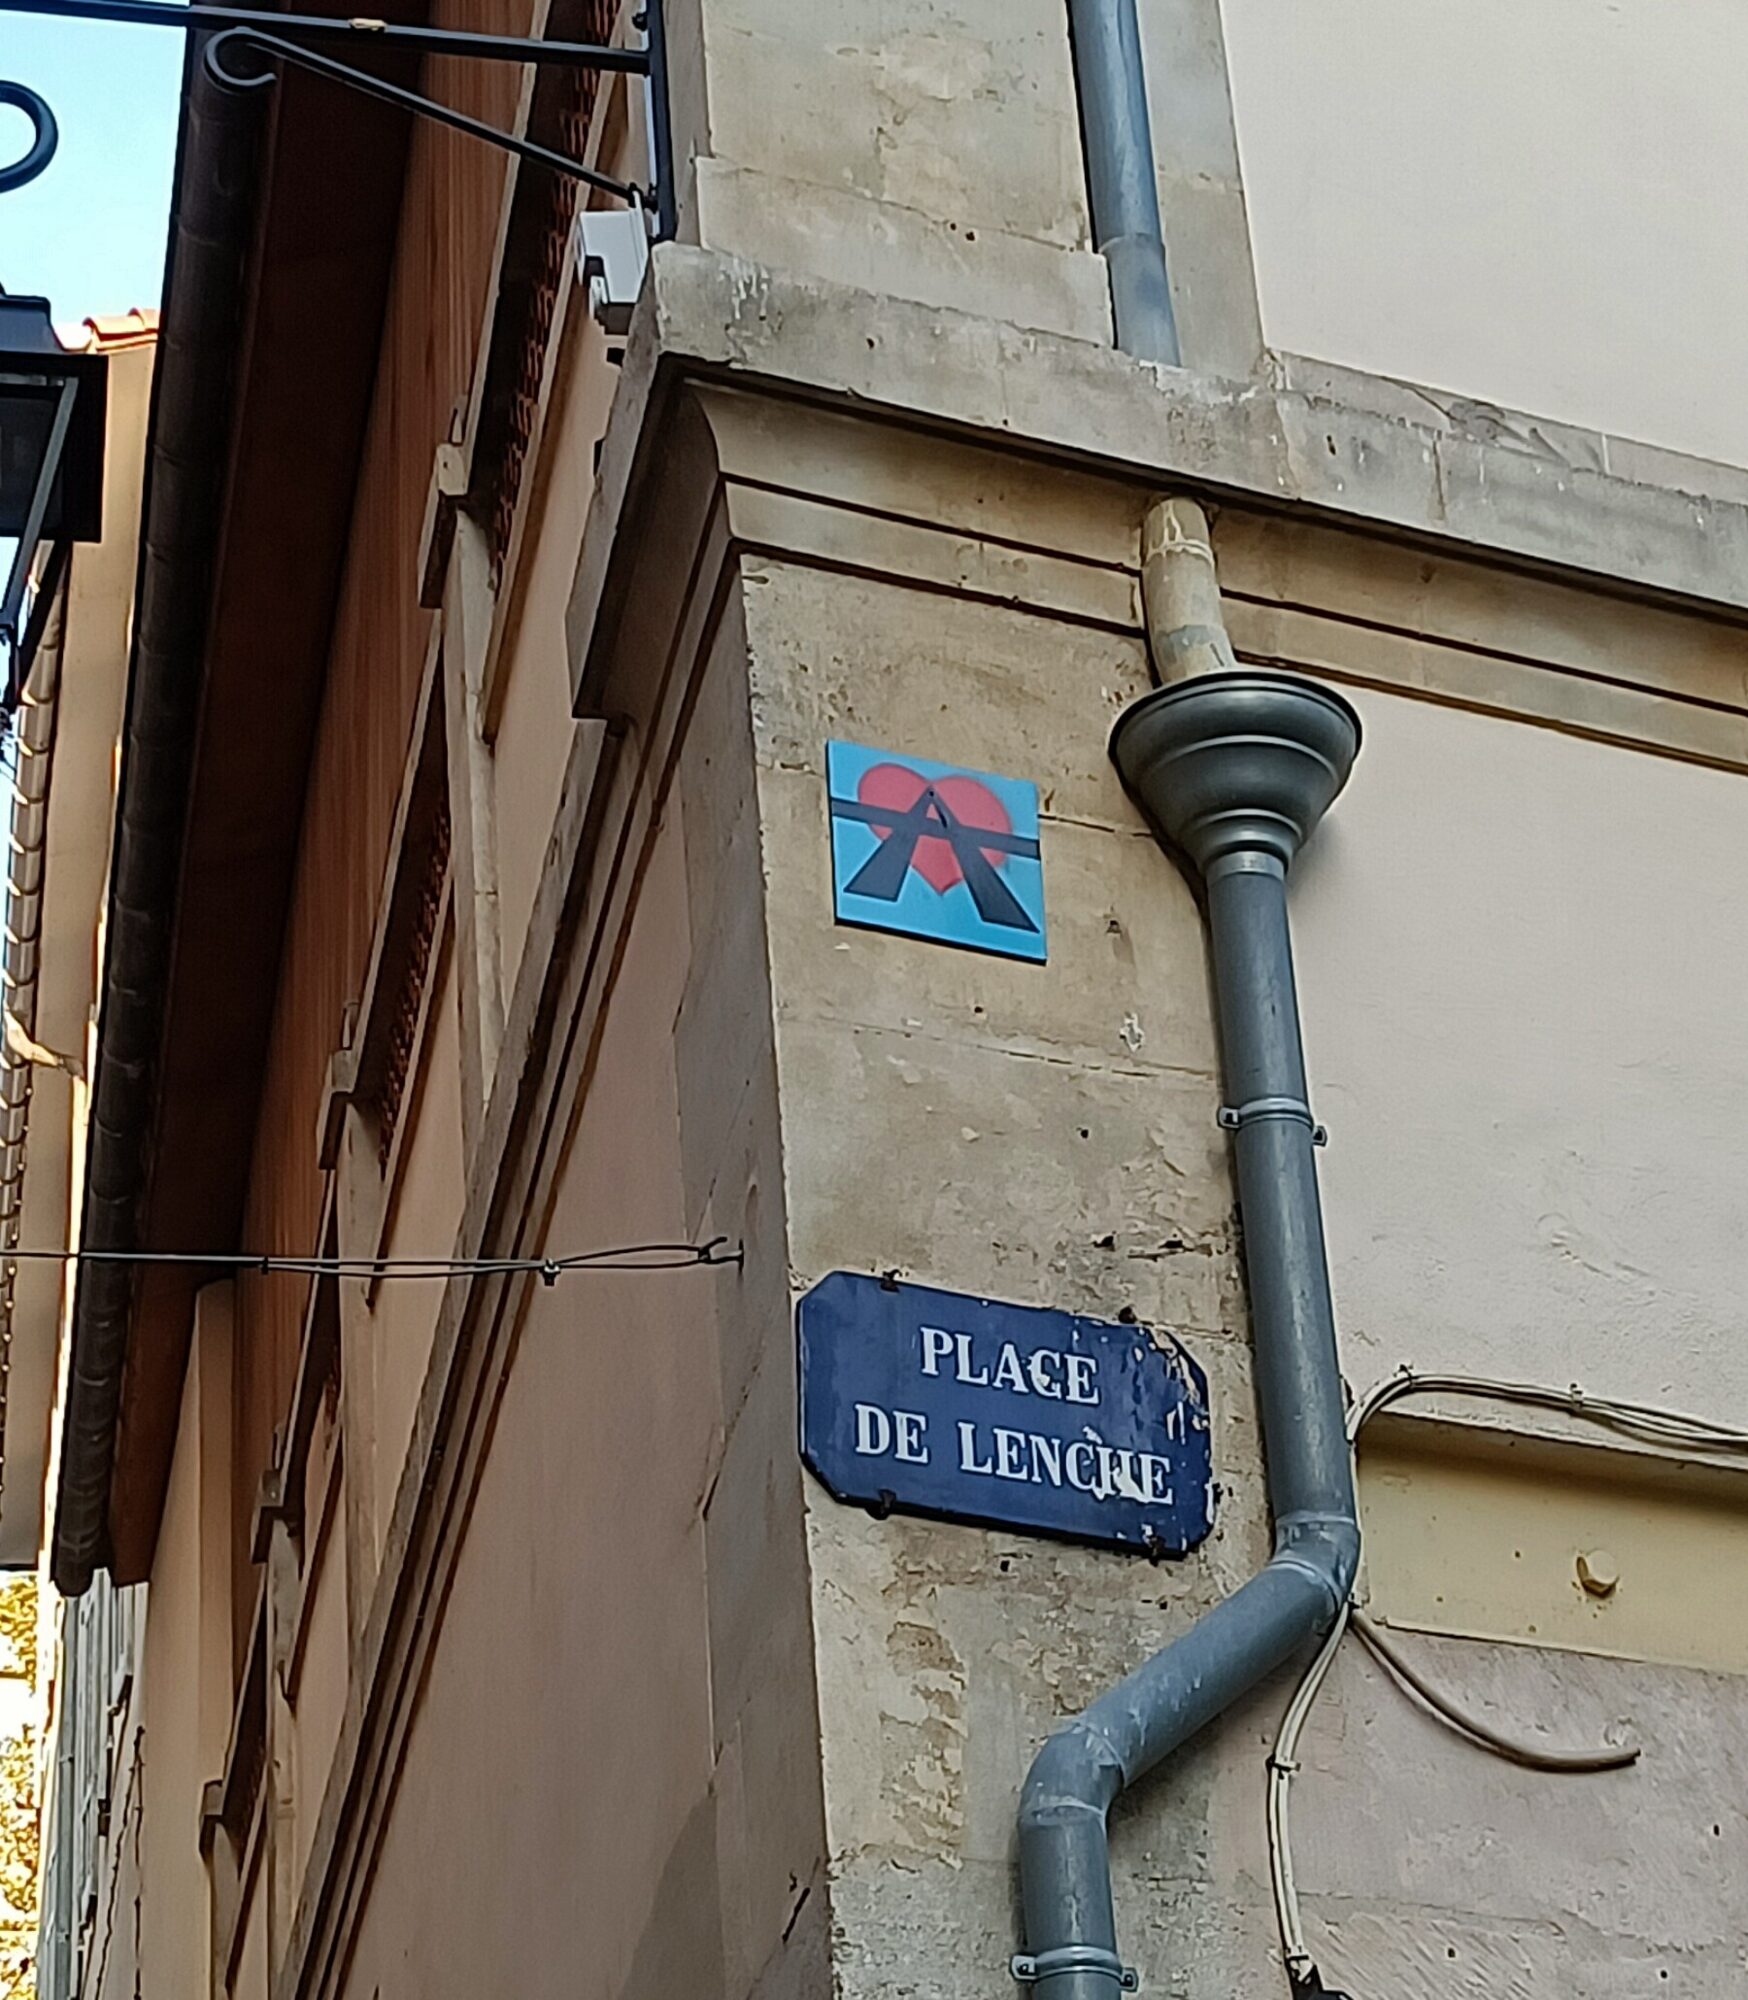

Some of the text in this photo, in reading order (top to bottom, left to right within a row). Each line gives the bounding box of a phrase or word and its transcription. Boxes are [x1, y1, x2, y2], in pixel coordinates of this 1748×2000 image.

[921, 1327, 1099, 1405] PLACE
[855, 1404, 1173, 1506] DE LENCHE
